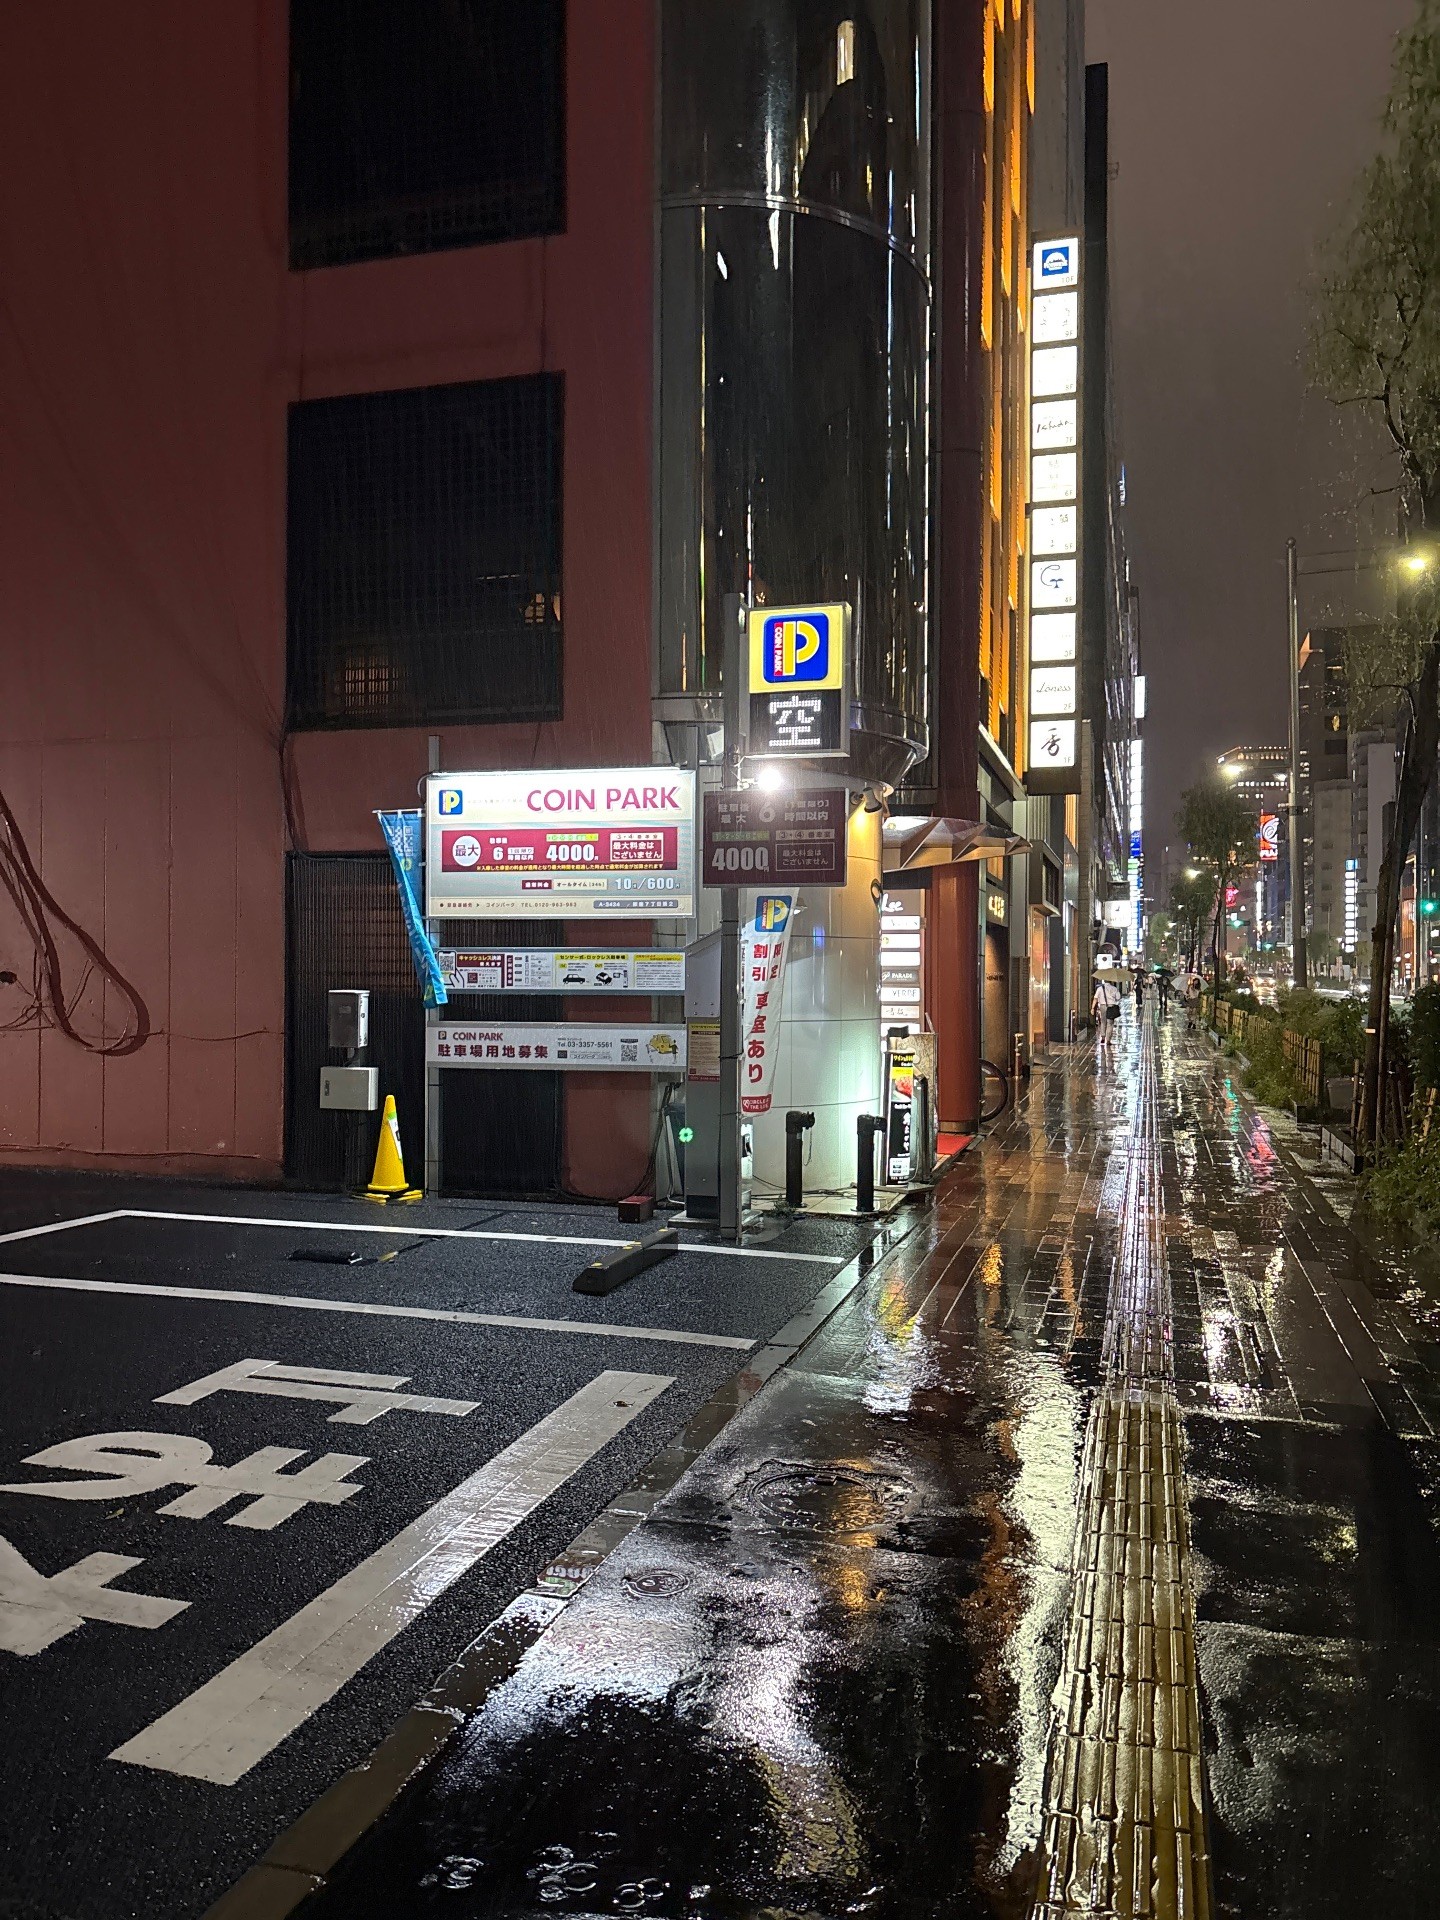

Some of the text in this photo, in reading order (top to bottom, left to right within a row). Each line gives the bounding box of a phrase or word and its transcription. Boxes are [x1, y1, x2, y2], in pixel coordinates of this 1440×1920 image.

[769, 695, 821, 747] 空
[526, 787, 680, 812] COIN PARK
[759, 801, 776, 823] 6
[455, 844, 479, 857] 最大
[613, 842, 655, 850] 最大料金は
[493, 847, 504, 860] 6
[613, 851, 662, 859] ございません
[453, 1032, 503, 1041] COIN PARK
[438, 1044, 548, 1058] 駐車場用地募集
